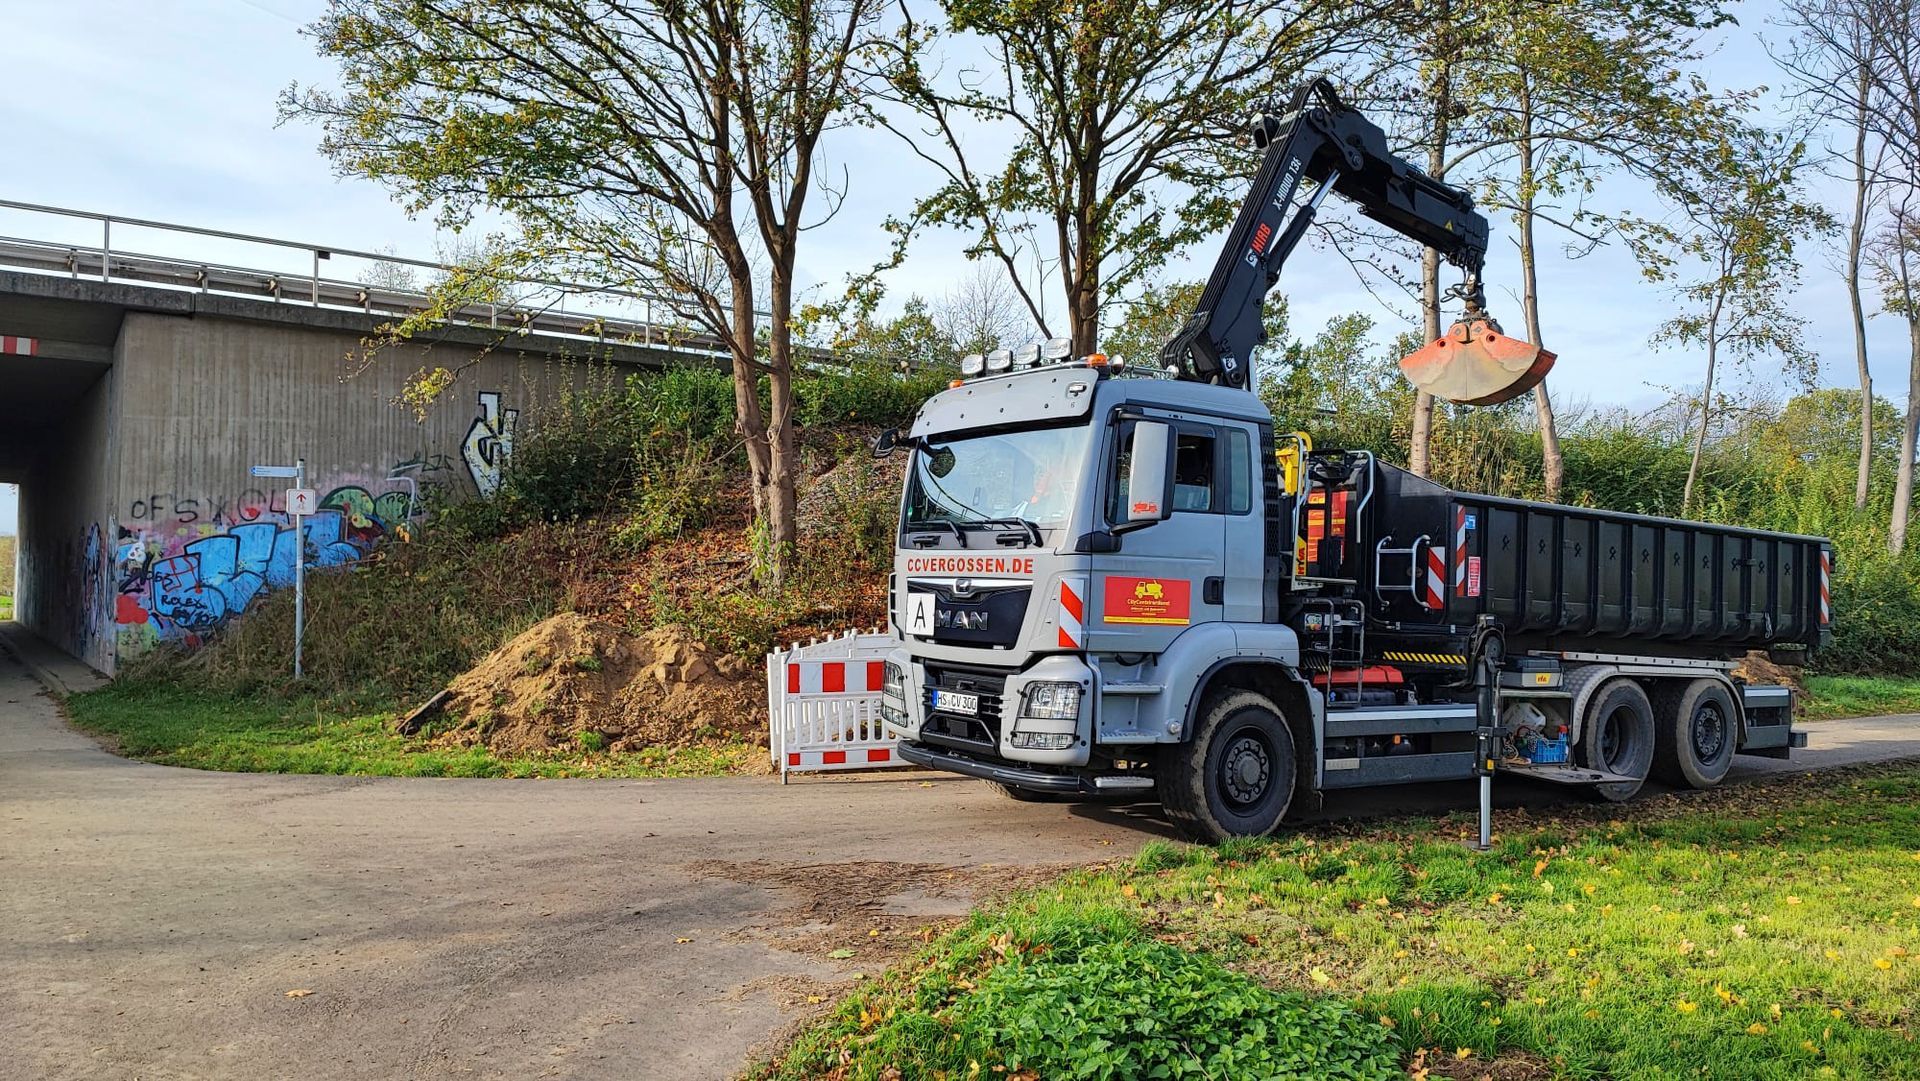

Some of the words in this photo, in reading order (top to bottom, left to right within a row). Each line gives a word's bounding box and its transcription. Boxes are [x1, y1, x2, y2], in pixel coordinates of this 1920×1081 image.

[1272, 172, 1295, 211] X-HIDUO
[1251, 222, 1272, 254] HIAB
[907, 558, 1034, 574] CCVERGOSSEN.DE
[1297, 547, 1305, 575] HYVA
[914, 599, 926, 628] A
[935, 609, 989, 631] MAN
[937, 692, 947, 706] HS
[951, 694, 962, 708] CV
[962, 696, 977, 710] 300
